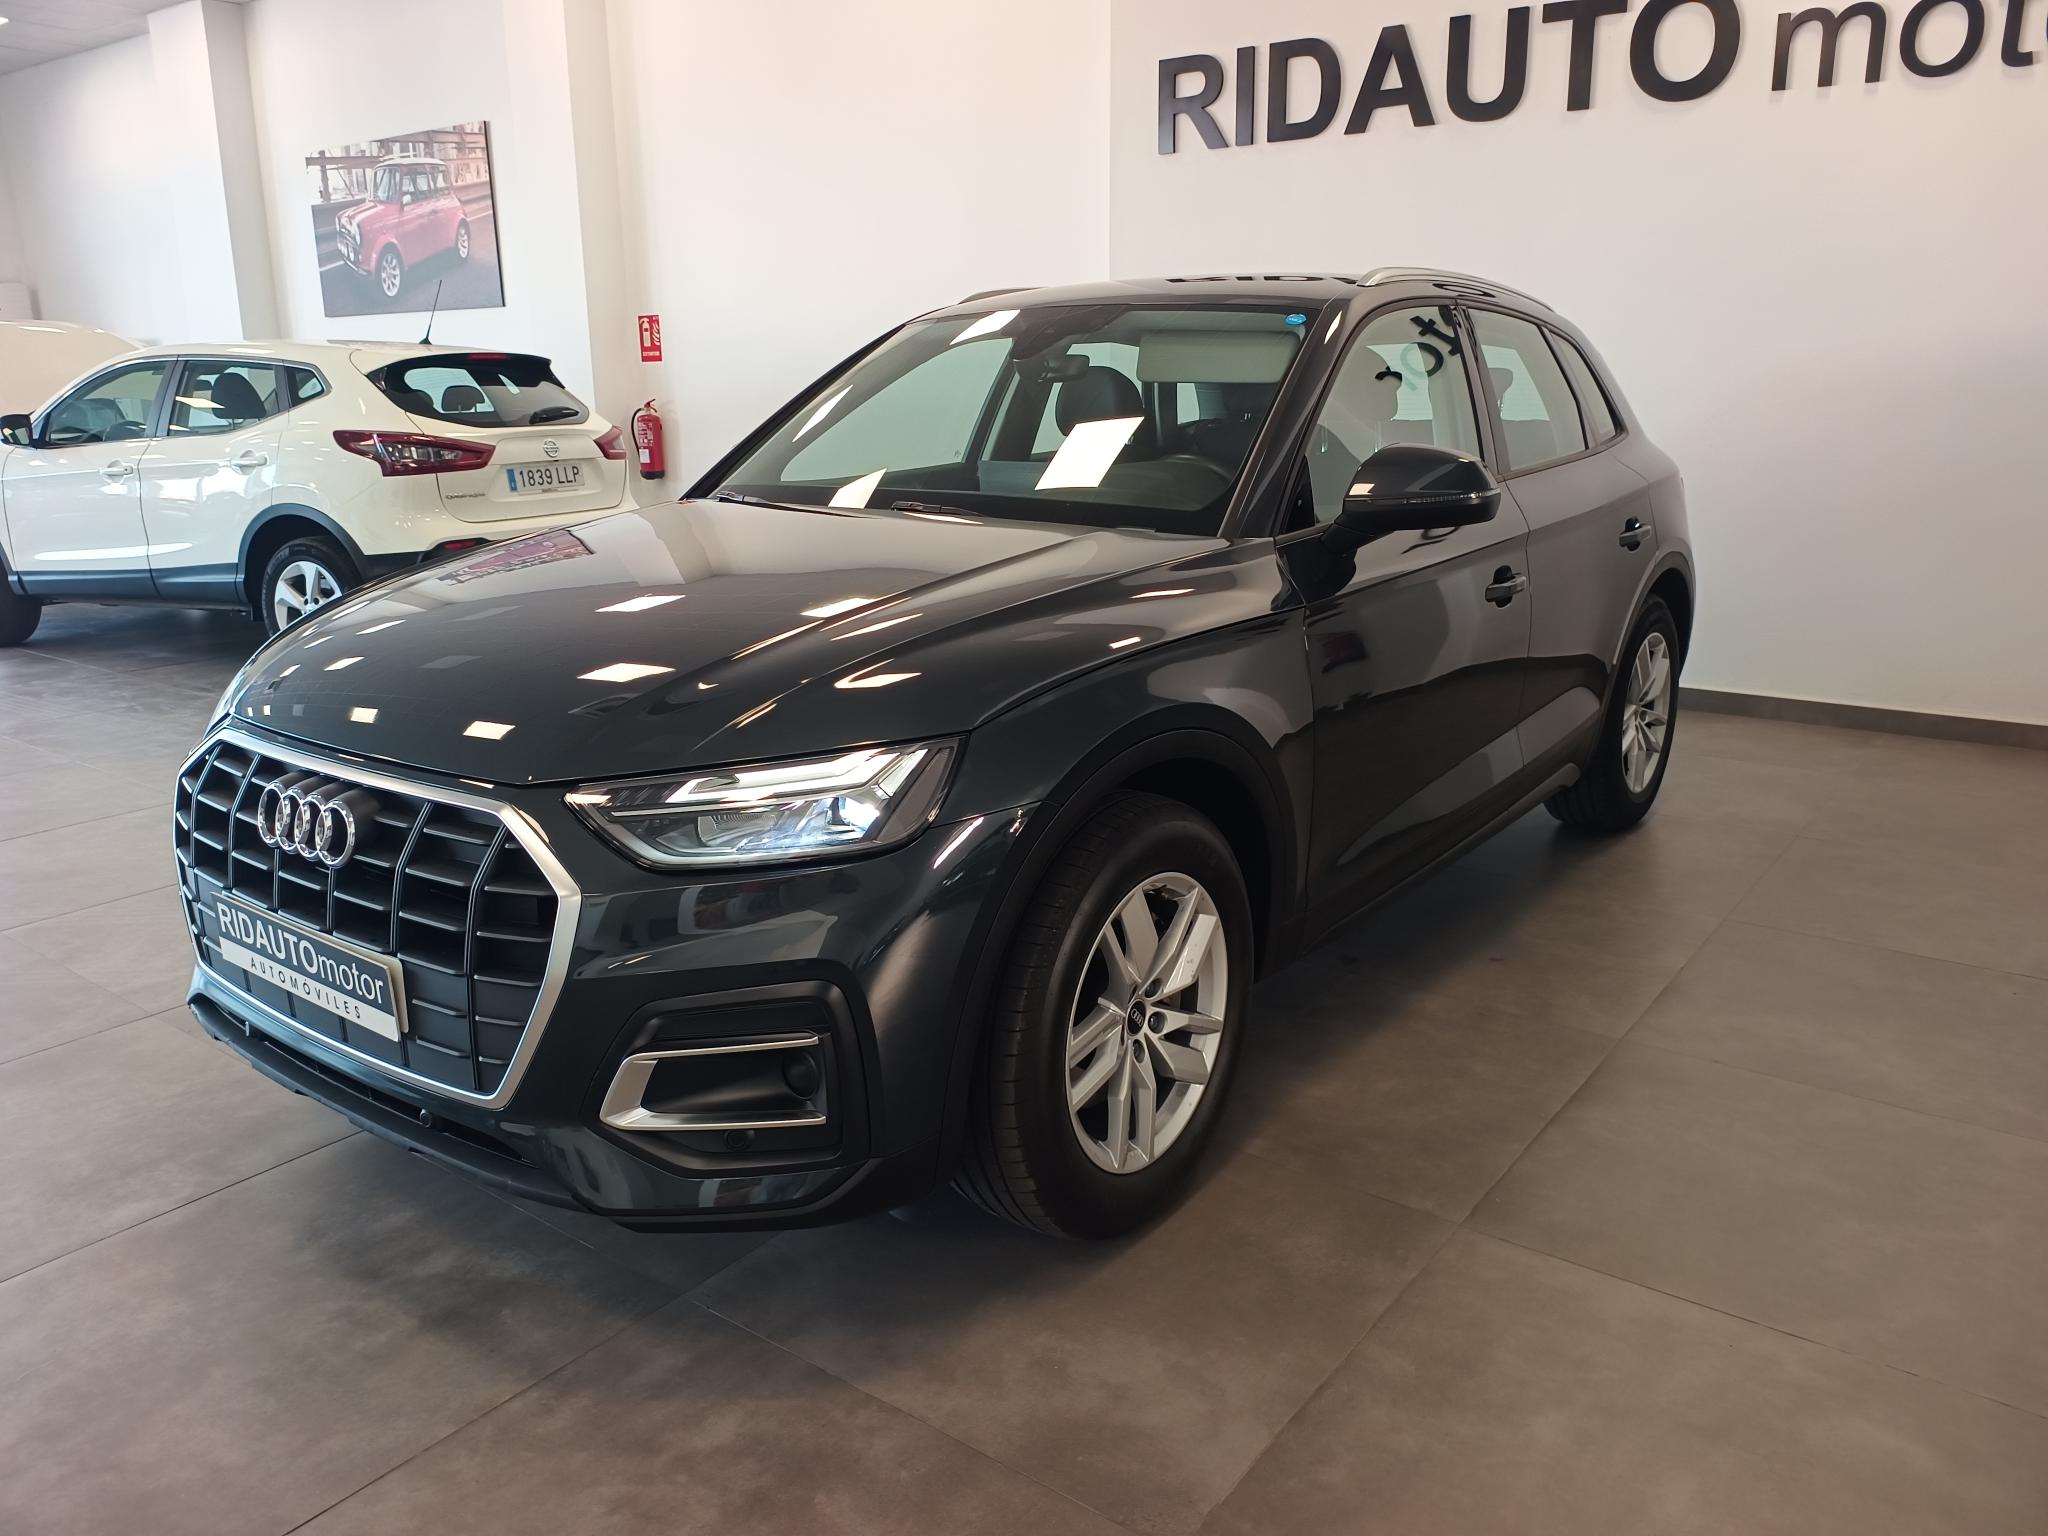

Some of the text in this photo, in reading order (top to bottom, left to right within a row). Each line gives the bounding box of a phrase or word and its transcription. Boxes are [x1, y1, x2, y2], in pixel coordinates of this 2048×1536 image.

[1771, 0, 2048, 92] mot
[519, 466, 580, 487] 1839 LLP
